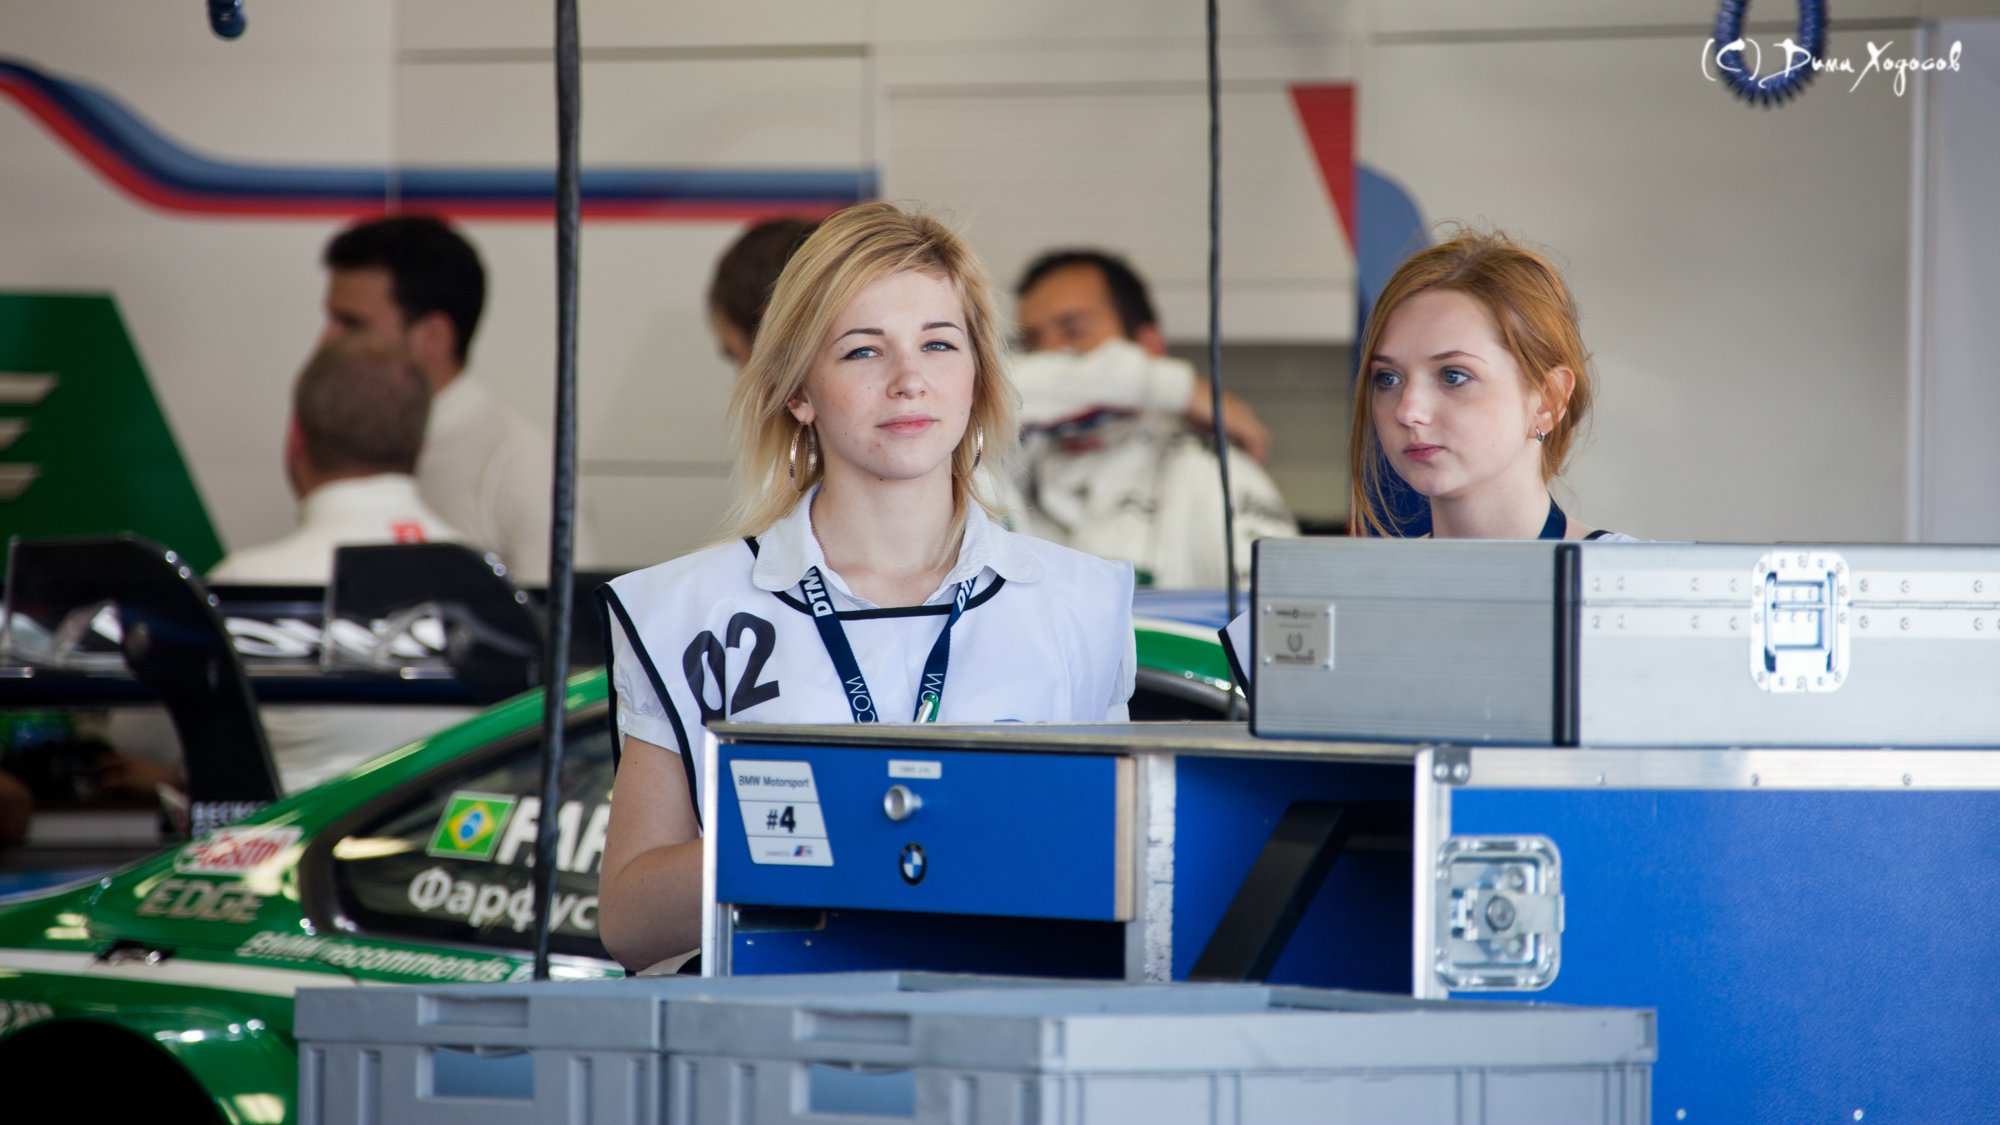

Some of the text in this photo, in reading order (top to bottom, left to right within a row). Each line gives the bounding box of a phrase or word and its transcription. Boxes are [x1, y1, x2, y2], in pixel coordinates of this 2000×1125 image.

[802, 568, 834, 618] DTM
[682, 612, 780, 726] 02
[738, 775, 810, 789] BMW Motorsport
[766, 806, 796, 834] #4
[136, 878, 263, 924] EDGE
[321, 936, 512, 981] recommends
